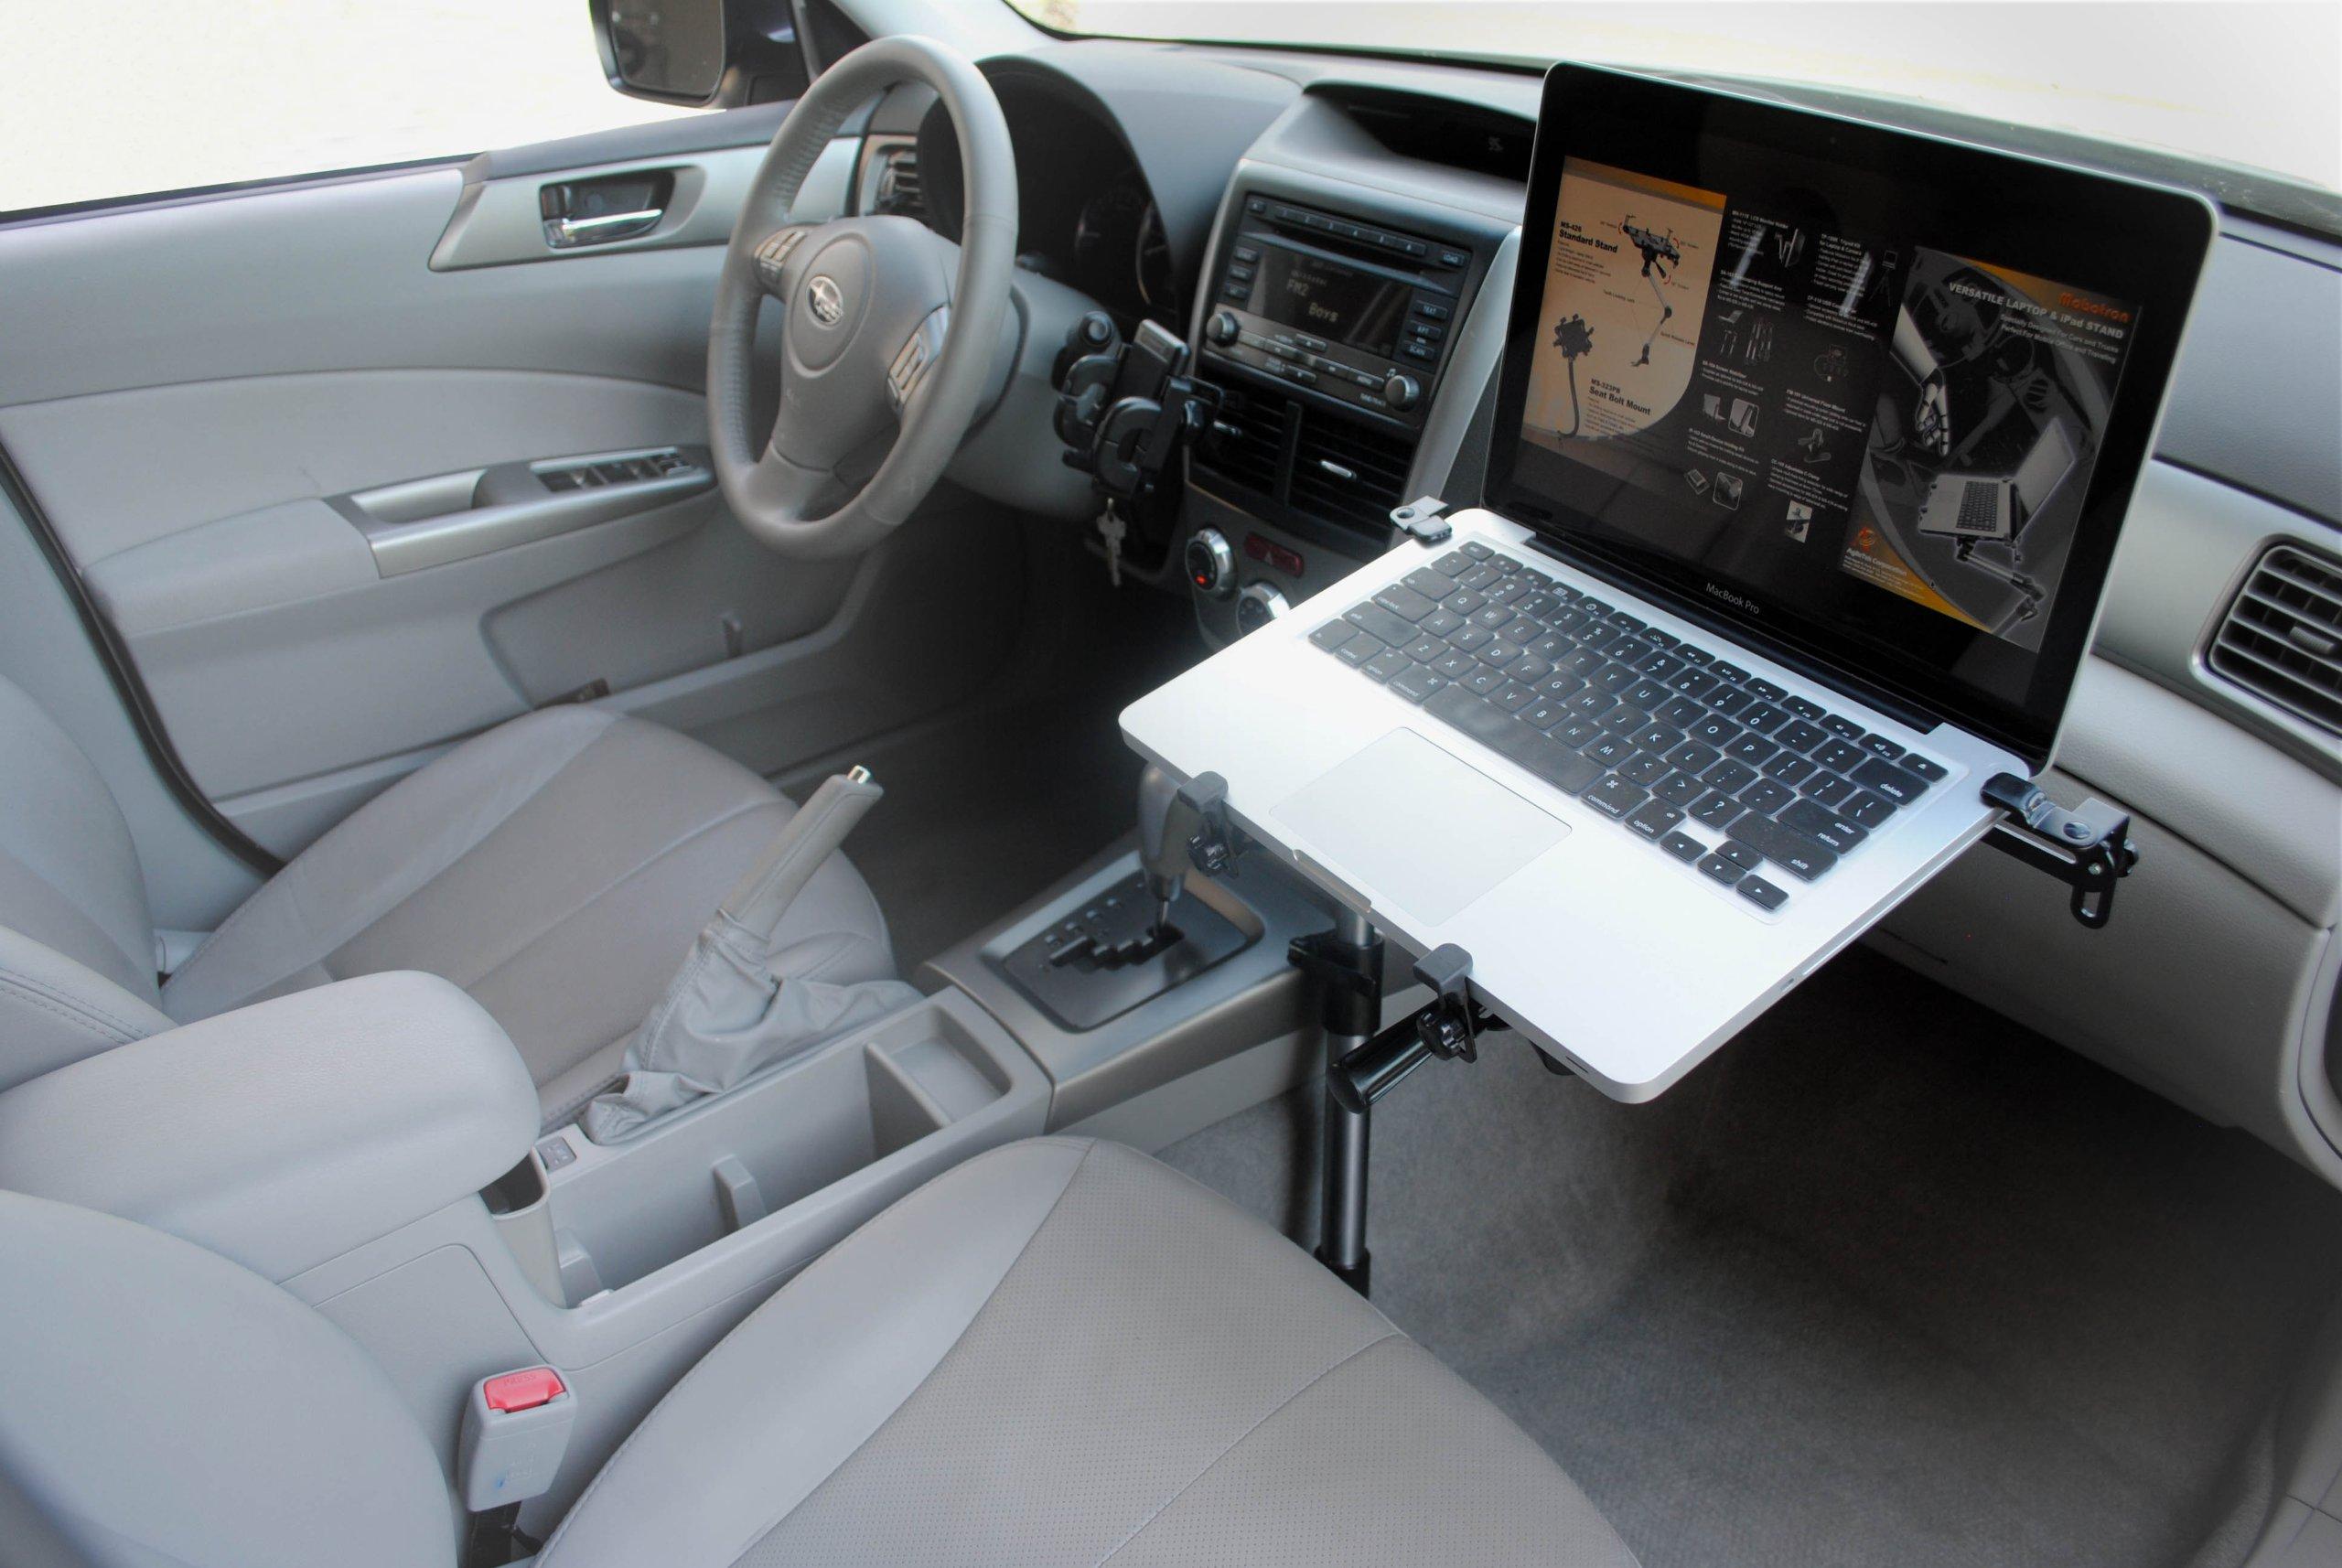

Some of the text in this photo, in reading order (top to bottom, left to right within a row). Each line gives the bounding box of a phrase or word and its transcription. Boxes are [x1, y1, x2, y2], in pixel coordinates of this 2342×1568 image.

[1559, 230, 1617, 253] Standard Stand
[1287, 278, 1310, 296] FM2
[1309, 302, 1338, 322] Boys
[1949, 283, 2123, 339] VERSATILE LAPTOP & iPad STAND
[2002, 324, 2022, 337] Perfect
[2023, 330, 2034, 339] For
[2075, 344, 2087, 354] and
[2027, 321, 2057, 336] Designed
[2068, 333, 2084, 343] Cars
[2084, 338, 2096, 347] and
[2097, 341, 2119, 354] Trucks
[1589, 387, 1651, 415] Seat Bolt Mount
[1706, 582, 1759, 615] MacBook Pro
[1367, 664, 1383, 676] option
[1392, 681, 1420, 697] command
[1638, 690, 1650, 698] U
[1582, 697, 1595, 706] H
[1649, 733, 1661, 742] K
[1600, 746, 1614, 755] M
[1880, 782, 1903, 798] delete
[1588, 794, 1620, 814] command
[1634, 820, 1655, 833] option
[1834, 821, 1854, 834] enter
[1818, 832, 1840, 847] return
[1791, 858, 1810, 870] shift
[503, 1374, 536, 1386] PRESS
